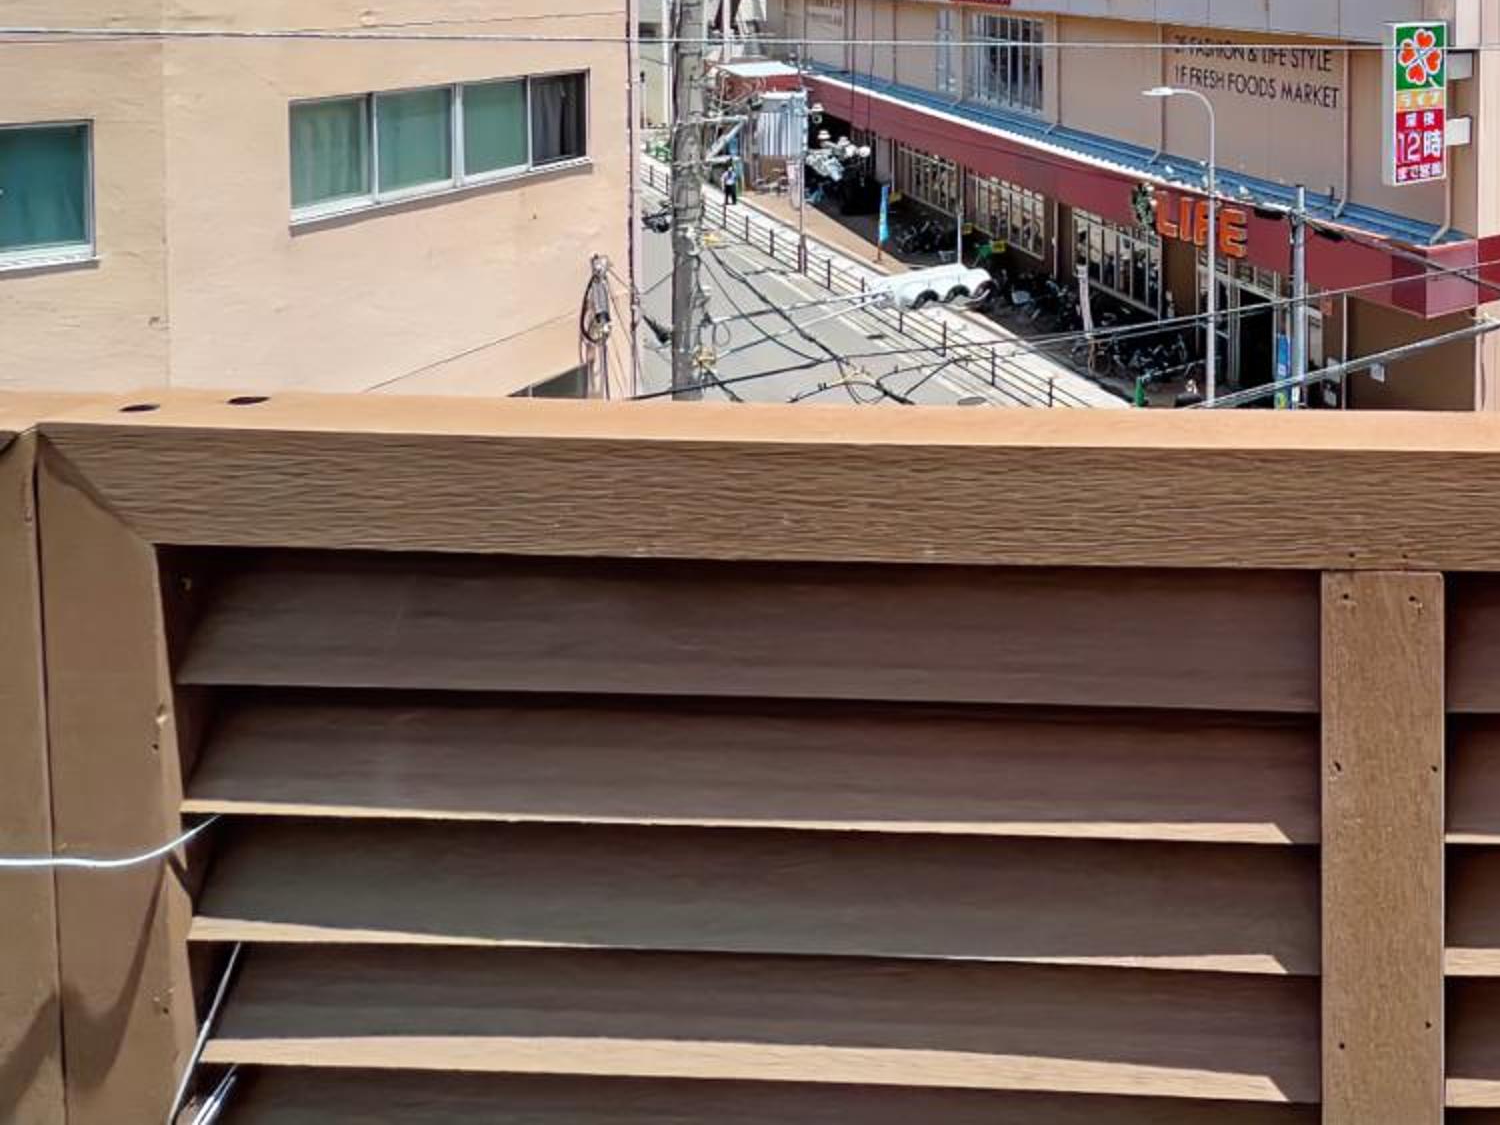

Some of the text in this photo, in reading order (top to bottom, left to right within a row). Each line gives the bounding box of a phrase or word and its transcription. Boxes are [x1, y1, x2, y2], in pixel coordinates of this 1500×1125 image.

[1189, 36, 1245, 60] FASHION
[1262, 46, 1287, 66] LIFE
[1290, 48, 1332, 72] STYLE
[1189, 66, 1225, 89] FRESH
[1227, 72, 1277, 99] FOODS
[1280, 81, 1340, 108] MARKET
[1398, 129, 1441, 164] 12時
[1154, 190, 1248, 259] LIFE
